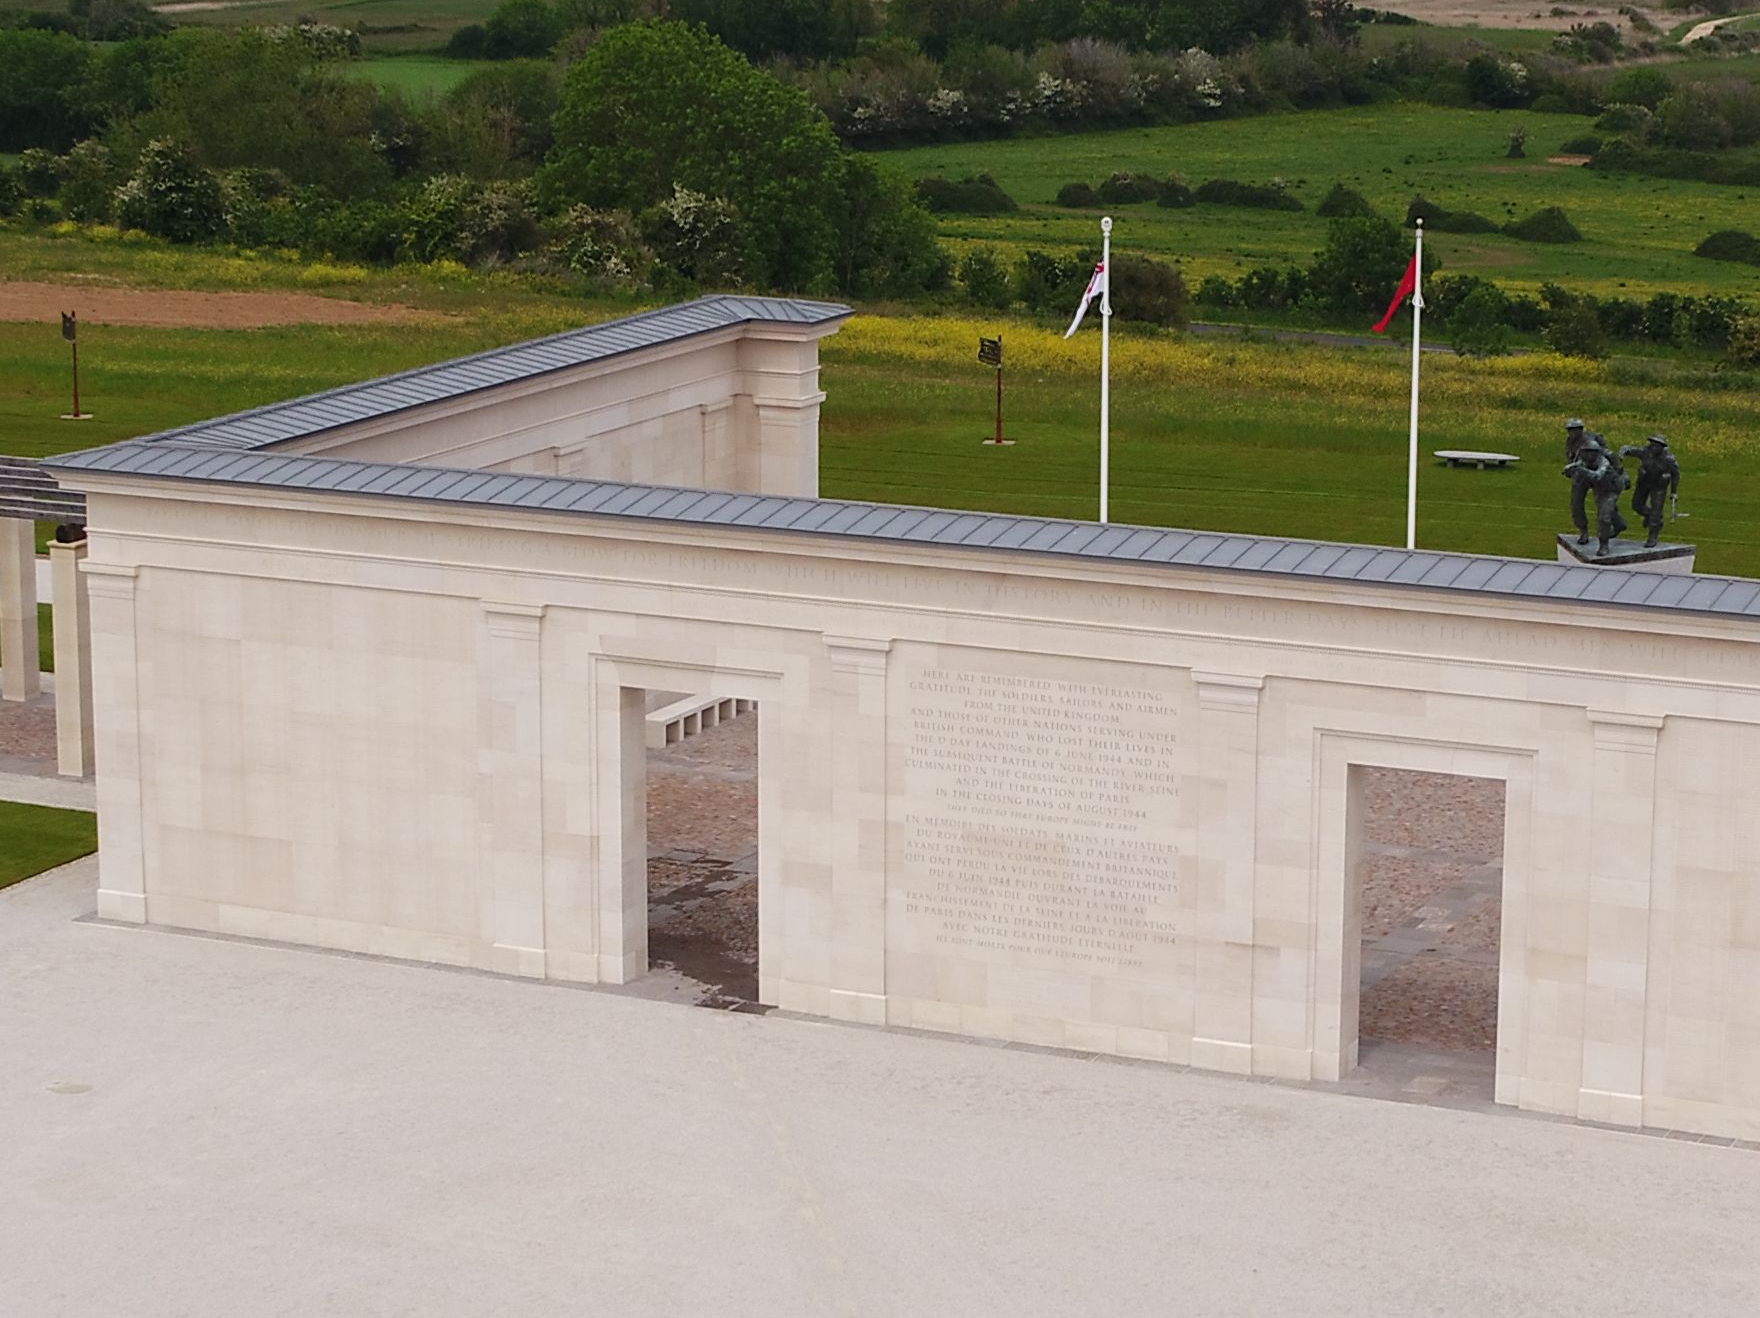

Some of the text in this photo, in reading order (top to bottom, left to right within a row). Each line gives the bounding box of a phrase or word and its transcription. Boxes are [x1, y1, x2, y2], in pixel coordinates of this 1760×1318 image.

[921, 669, 950, 681] HERE
[955, 672, 975, 683] ARE
[1056, 682, 1087, 694] WITH
[1091, 685, 1163, 701] EVERLASTING
[909, 707, 1177, 742] AND THOSE OF OTHER NATIONS SERVING UNDER
[963, 699, 993, 711] FROM
[997, 703, 1017, 713] THE
[1021, 705, 1060, 717] UNITED
[913, 720, 955, 733] BRITISH
[1026, 732, 1054, 743] WHO
[1057, 735, 1083, 746] LOST
[1088, 738, 1121, 750] THEIR
[1125, 742, 1156, 753] LIVES
[1160, 745, 1174, 755] IN
[914, 733, 933, 744] THE
[975, 740, 1032, 754] LANDINGS
[1035, 746, 1050, 756] OF
[1065, 749, 1093, 760] JUNE
[1097, 752, 1122, 763] 1944
[1126, 755, 1152, 766] AND
[1156, 758, 1170, 768] IN
[904, 758, 971, 774] CULMINATED
[974, 766, 987, 776] IN
[991, 768, 1010, 778] THE
[1014, 770, 1067, 784] CROSSING
[1070, 776, 1084, 786] OF
[1088, 778, 1108, 788] THE
[1112, 780, 1145, 792] RIVER
[909, 746, 929, 756] THE
[932, 748, 998, 764] SUBSEQUENT
[1001, 755, 1037, 768] BATTLE
[1040, 760, 1054, 770] OF
[1133, 769, 1175, 782] WHICH
[935, 787, 1147, 819] IN THE CLOSING DAYS OF AUGUST 1944
[955, 777, 980, 787] AND
[984, 780, 1003, 790] THE
[1008, 782, 1075, 798] LIBERATION
[1079, 790, 1093, 800] OF
